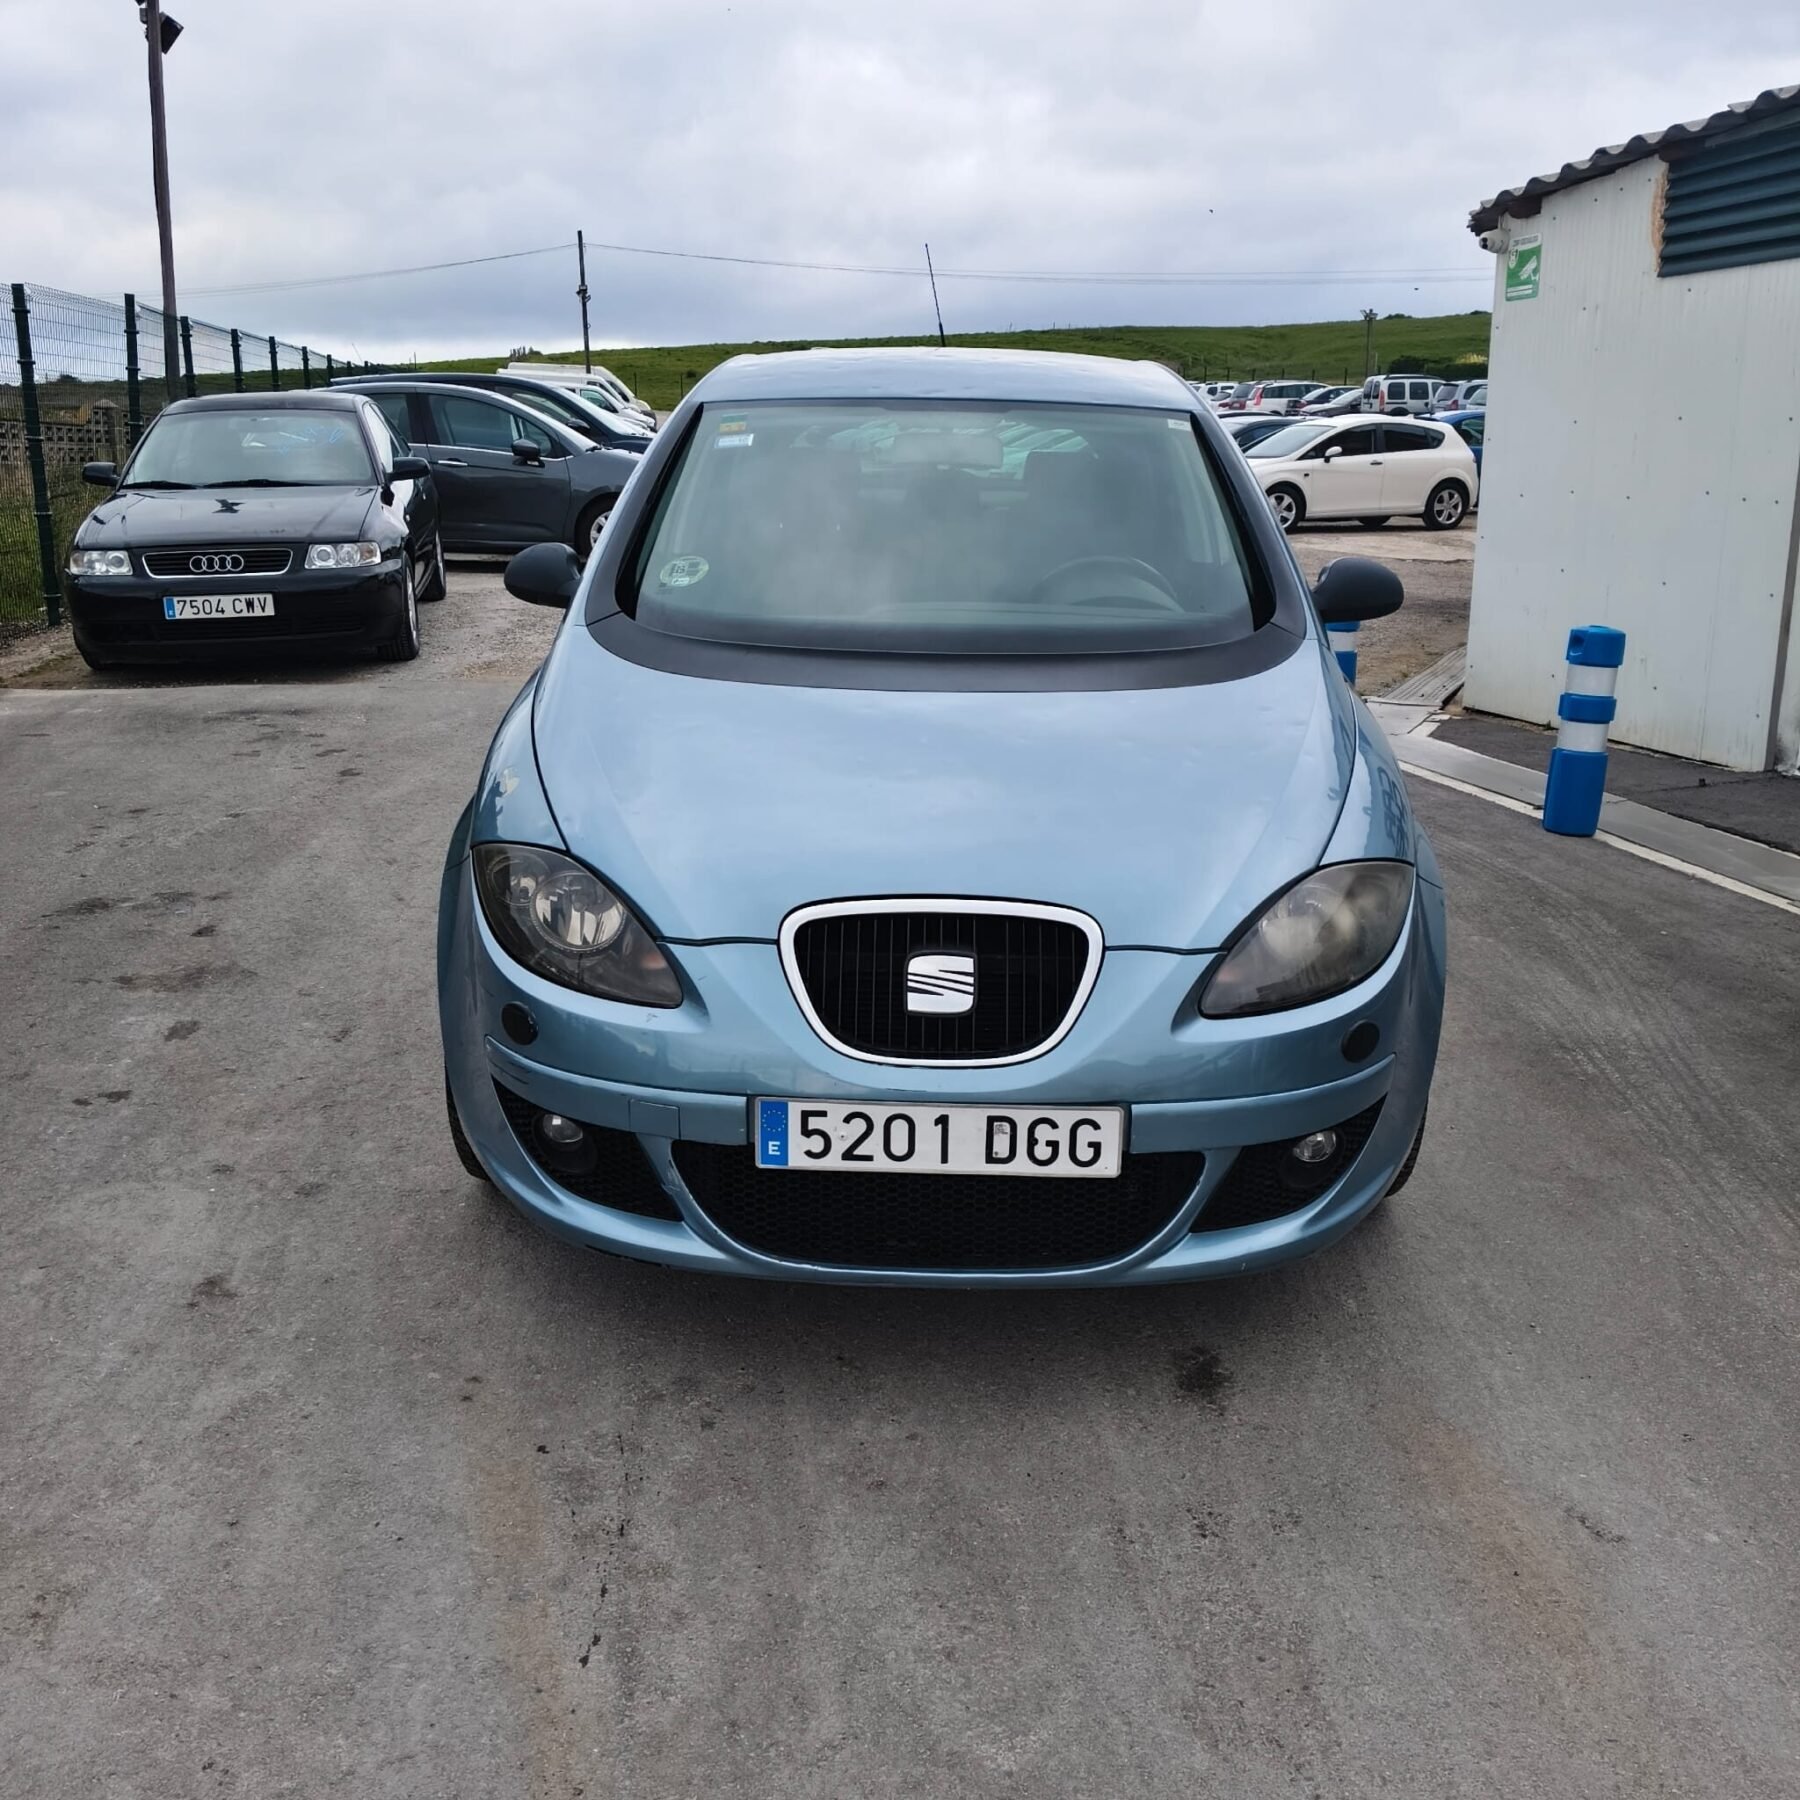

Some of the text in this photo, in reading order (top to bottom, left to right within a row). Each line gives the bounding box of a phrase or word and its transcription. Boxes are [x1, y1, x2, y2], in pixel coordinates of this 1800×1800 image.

[177, 596, 267, 616] 7504 CWV
[768, 1110, 1102, 1168] E 5201 DGG
